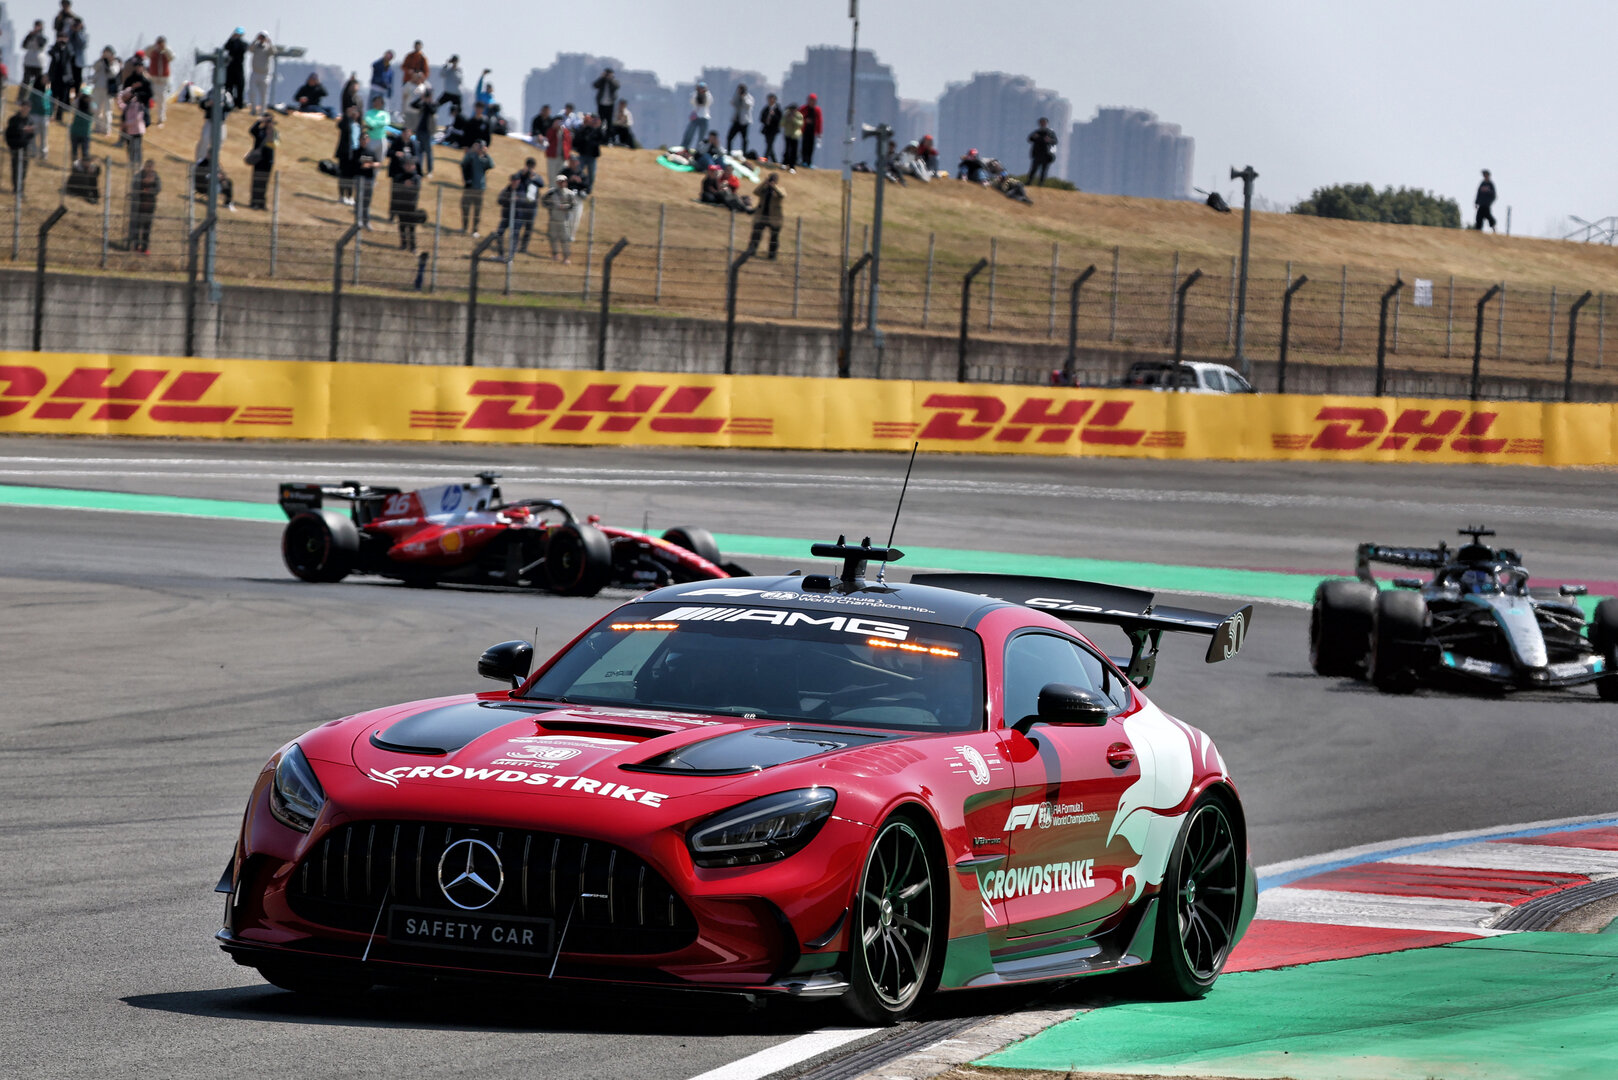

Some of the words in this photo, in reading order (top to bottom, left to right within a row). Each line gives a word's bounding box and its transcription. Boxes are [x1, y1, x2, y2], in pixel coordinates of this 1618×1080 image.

[464, 379, 728, 433] DHL
[917, 393, 1145, 446] DHL
[1310, 405, 1508, 453] DHL
[385, 495, 410, 515] 16
[799, 597, 834, 605] World
[825, 595, 873, 603] Formula
[1224, 611, 1245, 660] 30
[506, 745, 582, 761] 30
[386, 765, 669, 808] CROWDSTRIKE
[1003, 804, 1039, 831] F1
[1054, 816, 1066, 825] World
[1062, 804, 1080, 813] Formula
[982, 858, 1095, 900] CROWDSTRIKE
[405, 918, 483, 941] SAFETY
[491, 926, 535, 946] CAR
